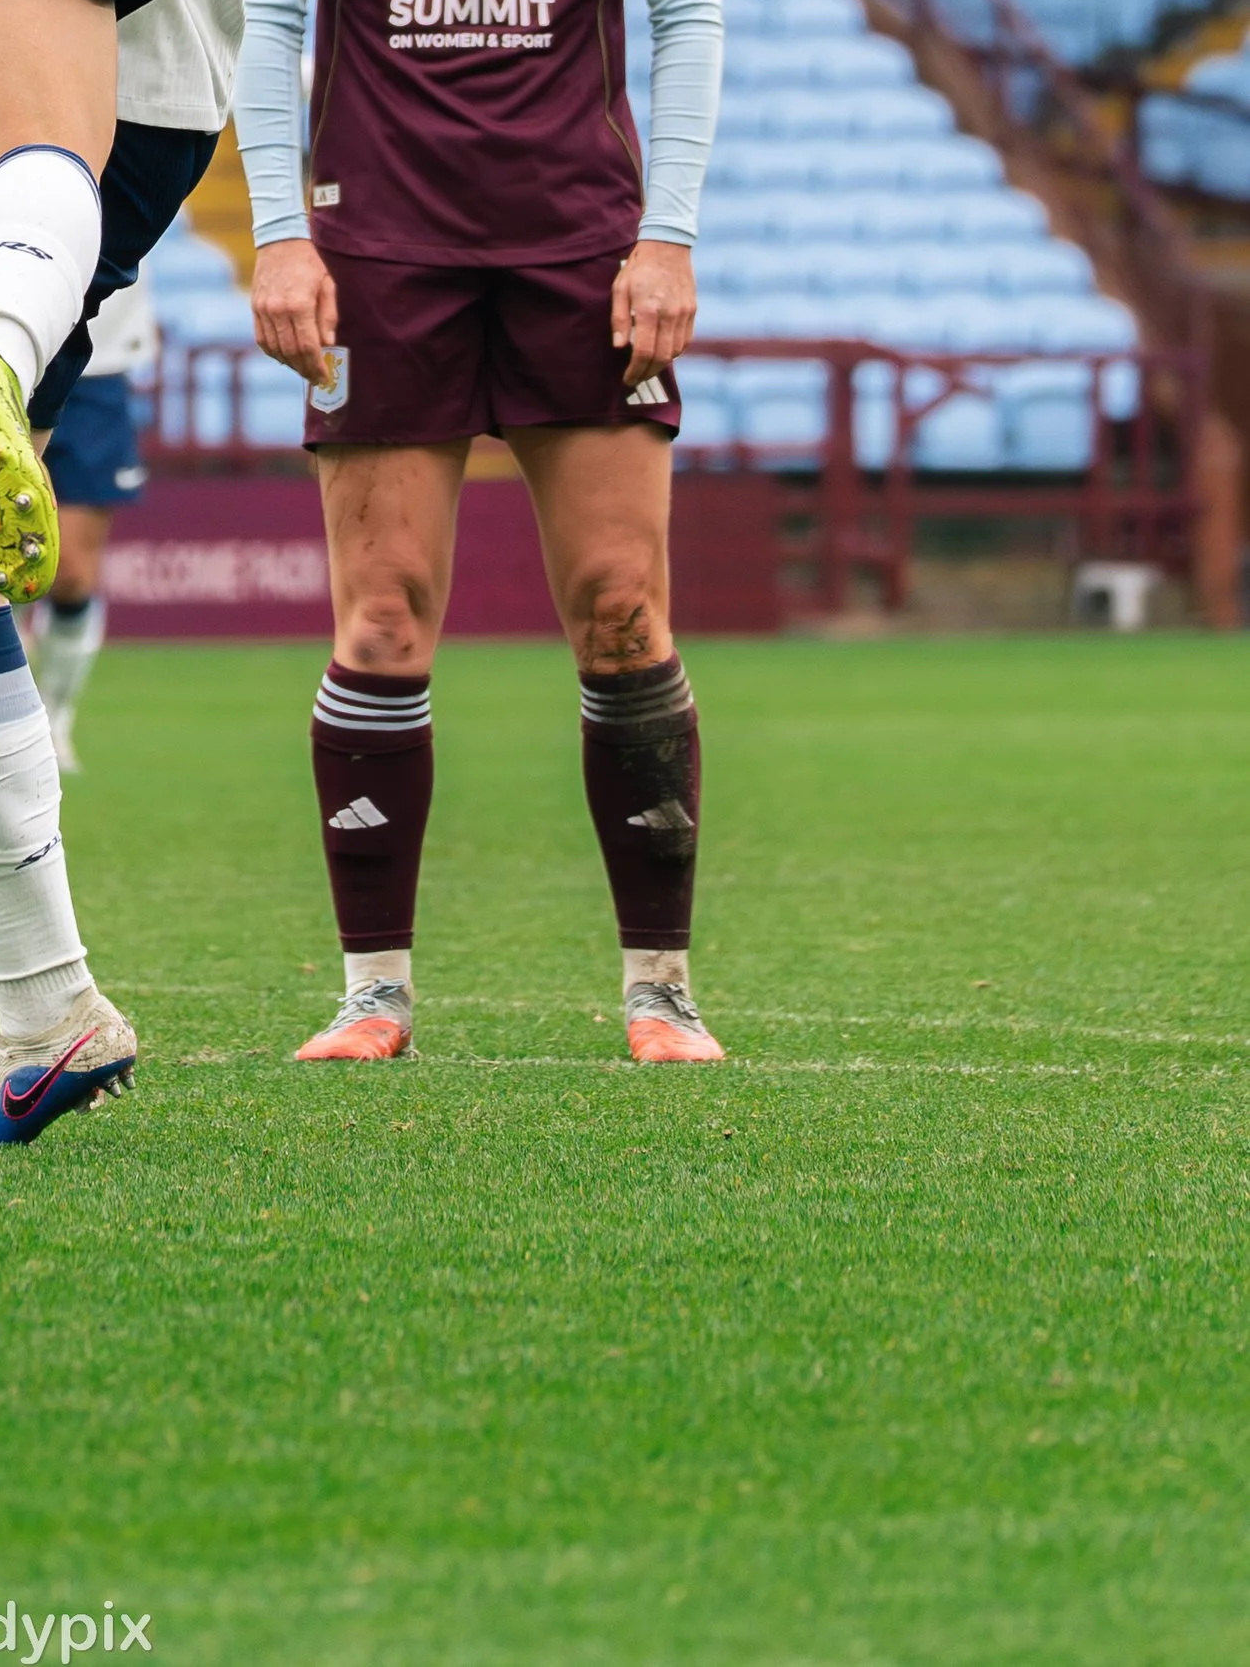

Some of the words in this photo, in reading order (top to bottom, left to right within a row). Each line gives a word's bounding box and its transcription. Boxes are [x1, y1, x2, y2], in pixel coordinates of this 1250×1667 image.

[389, 34, 413, 49] ON
[415, 33, 485, 48] WOMEN
[486, 33, 499, 48] &
[501, 33, 553, 49] SPORT
